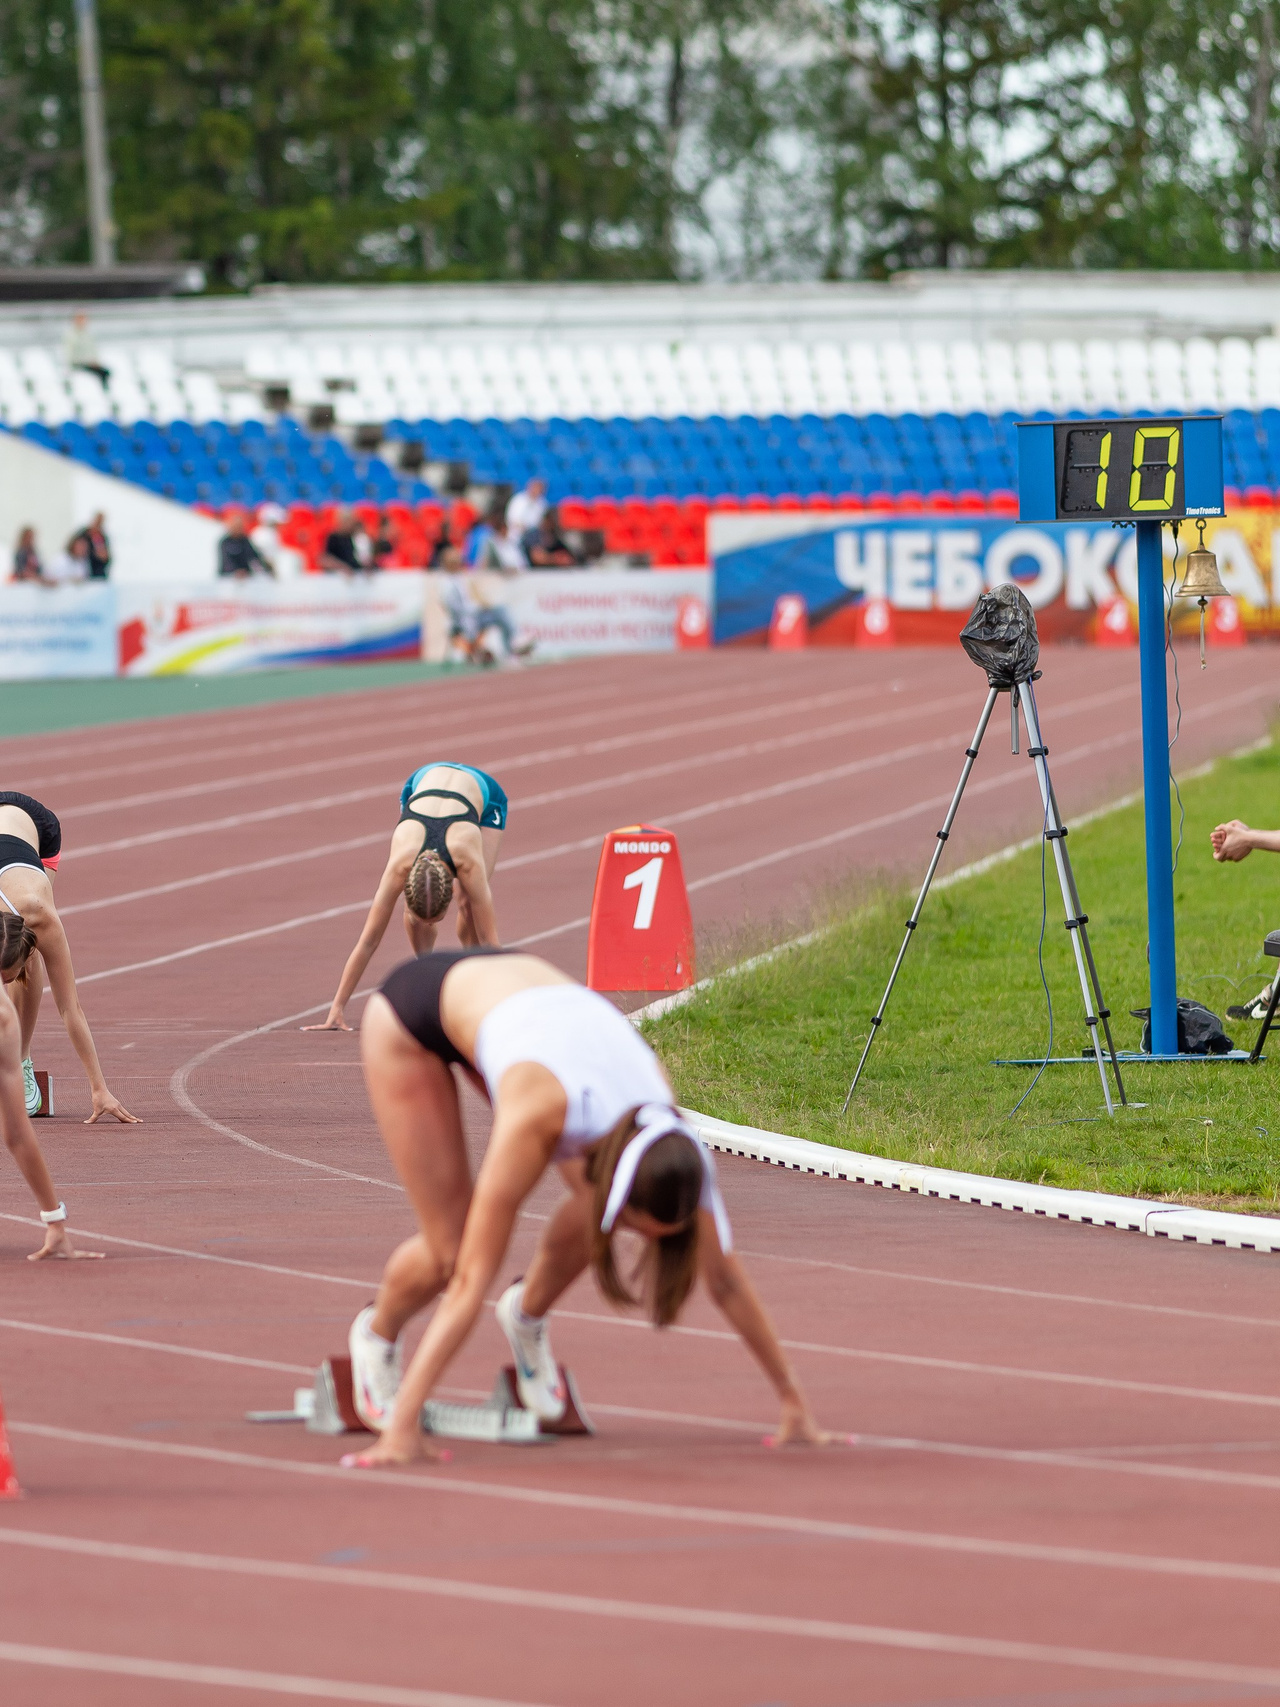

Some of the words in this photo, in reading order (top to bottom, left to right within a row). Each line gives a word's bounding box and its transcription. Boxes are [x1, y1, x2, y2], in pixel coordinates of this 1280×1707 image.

[1096, 427, 1180, 511] 10
[833, 528, 1280, 611] ЧЕБОКСА
[777, 599, 801, 634] 7
[1215, 598, 1238, 632] 3
[614, 841, 671, 854] MONDO
[623, 857, 664, 930] 1
